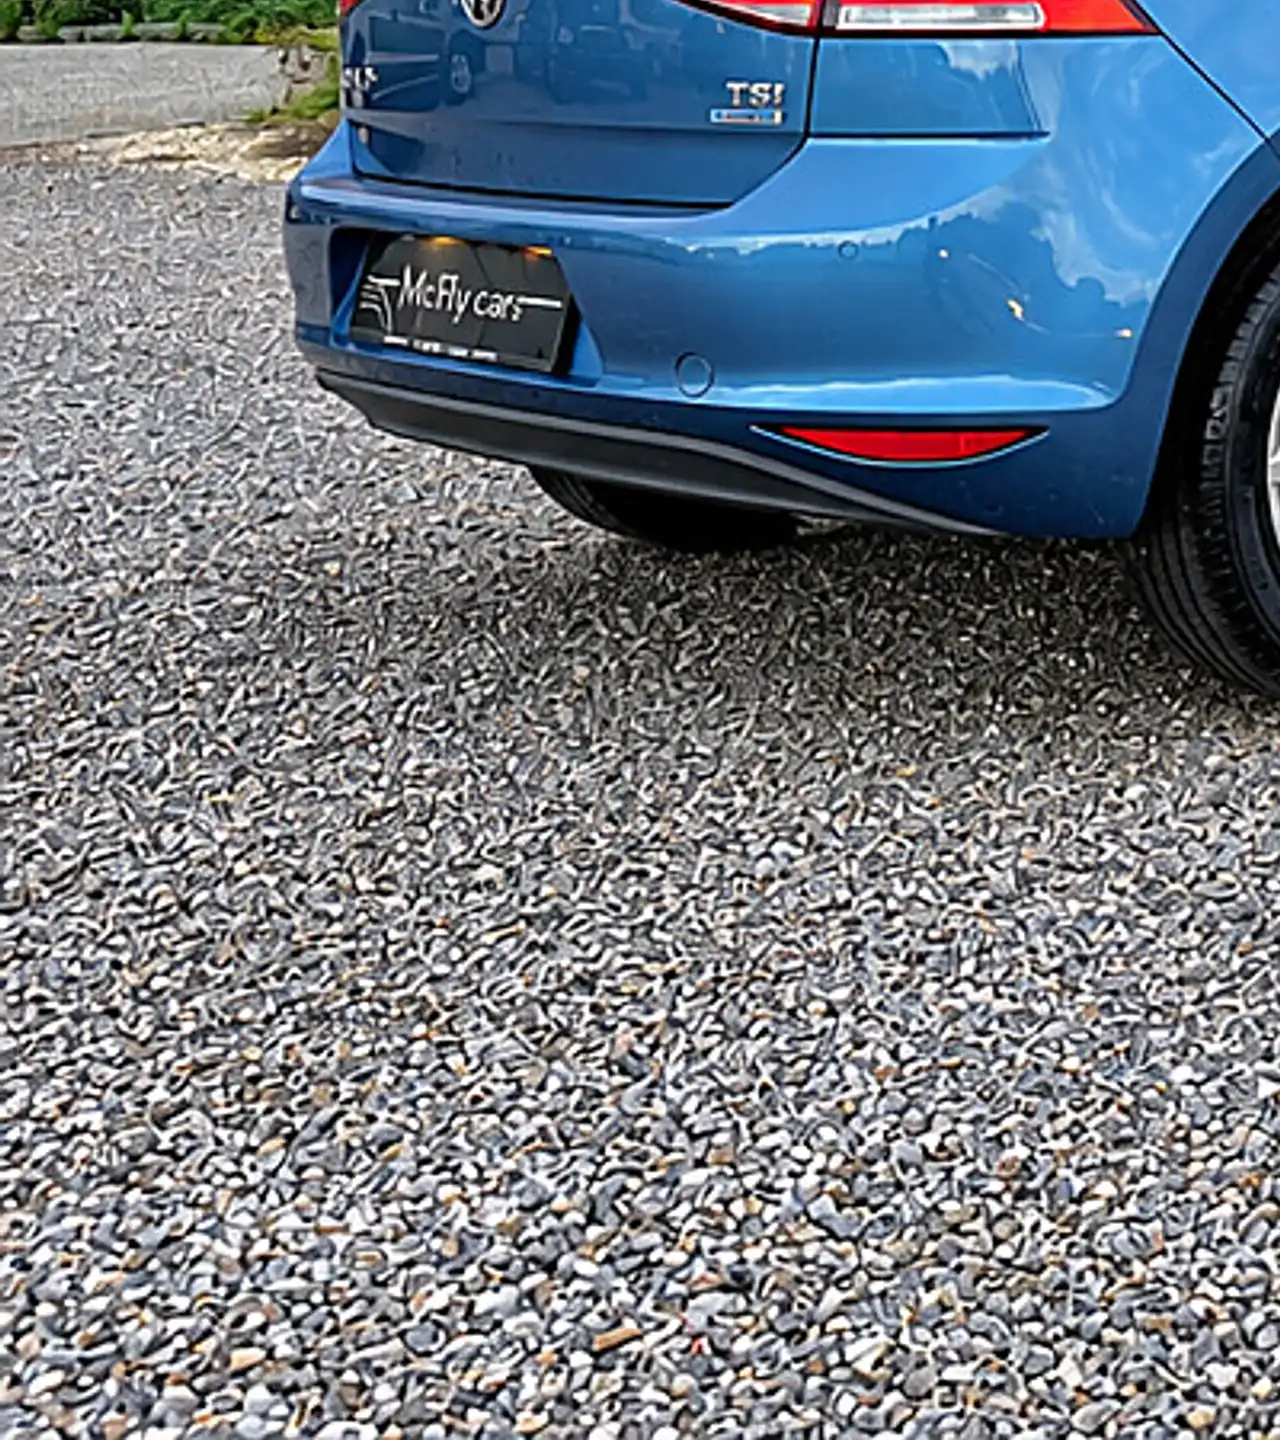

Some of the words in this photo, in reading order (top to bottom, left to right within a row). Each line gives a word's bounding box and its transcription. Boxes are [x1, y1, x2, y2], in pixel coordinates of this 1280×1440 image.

[725, 81, 785, 107] TSI
[397, 263, 472, 324] McFly
[473, 289, 524, 323] cars
